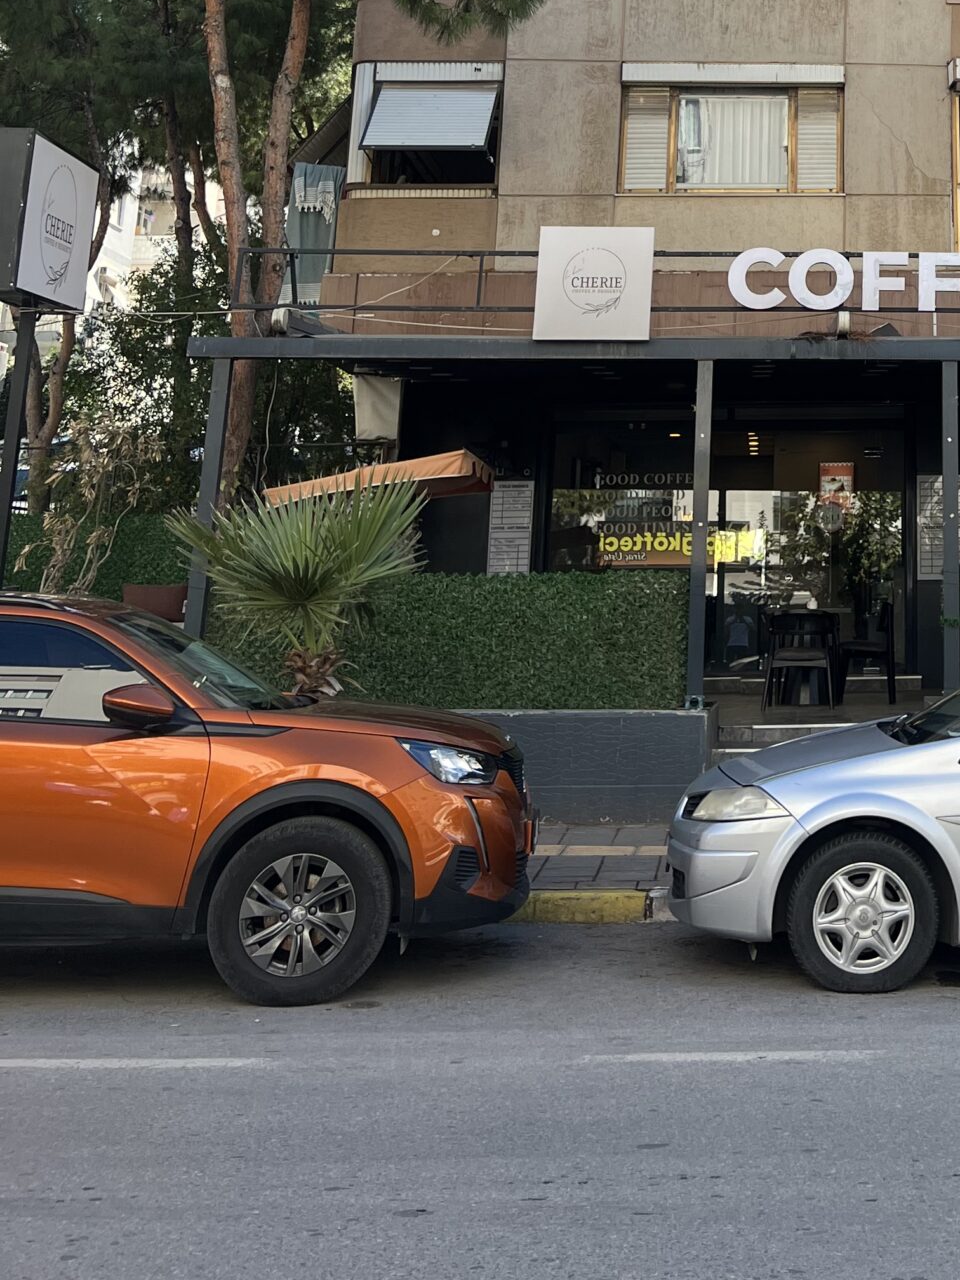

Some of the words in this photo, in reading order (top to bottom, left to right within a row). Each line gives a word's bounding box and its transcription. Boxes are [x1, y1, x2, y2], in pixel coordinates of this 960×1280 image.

[45, 213, 74, 245] CHERIE
[571, 276, 622, 288] CHERIE
[594, 473, 640, 486] GOOD
[643, 472, 694, 485] COFFE
[642, 505, 692, 518] PEOPL
[592, 523, 637, 535] GOOD
[643, 522, 690, 533] TIMES
